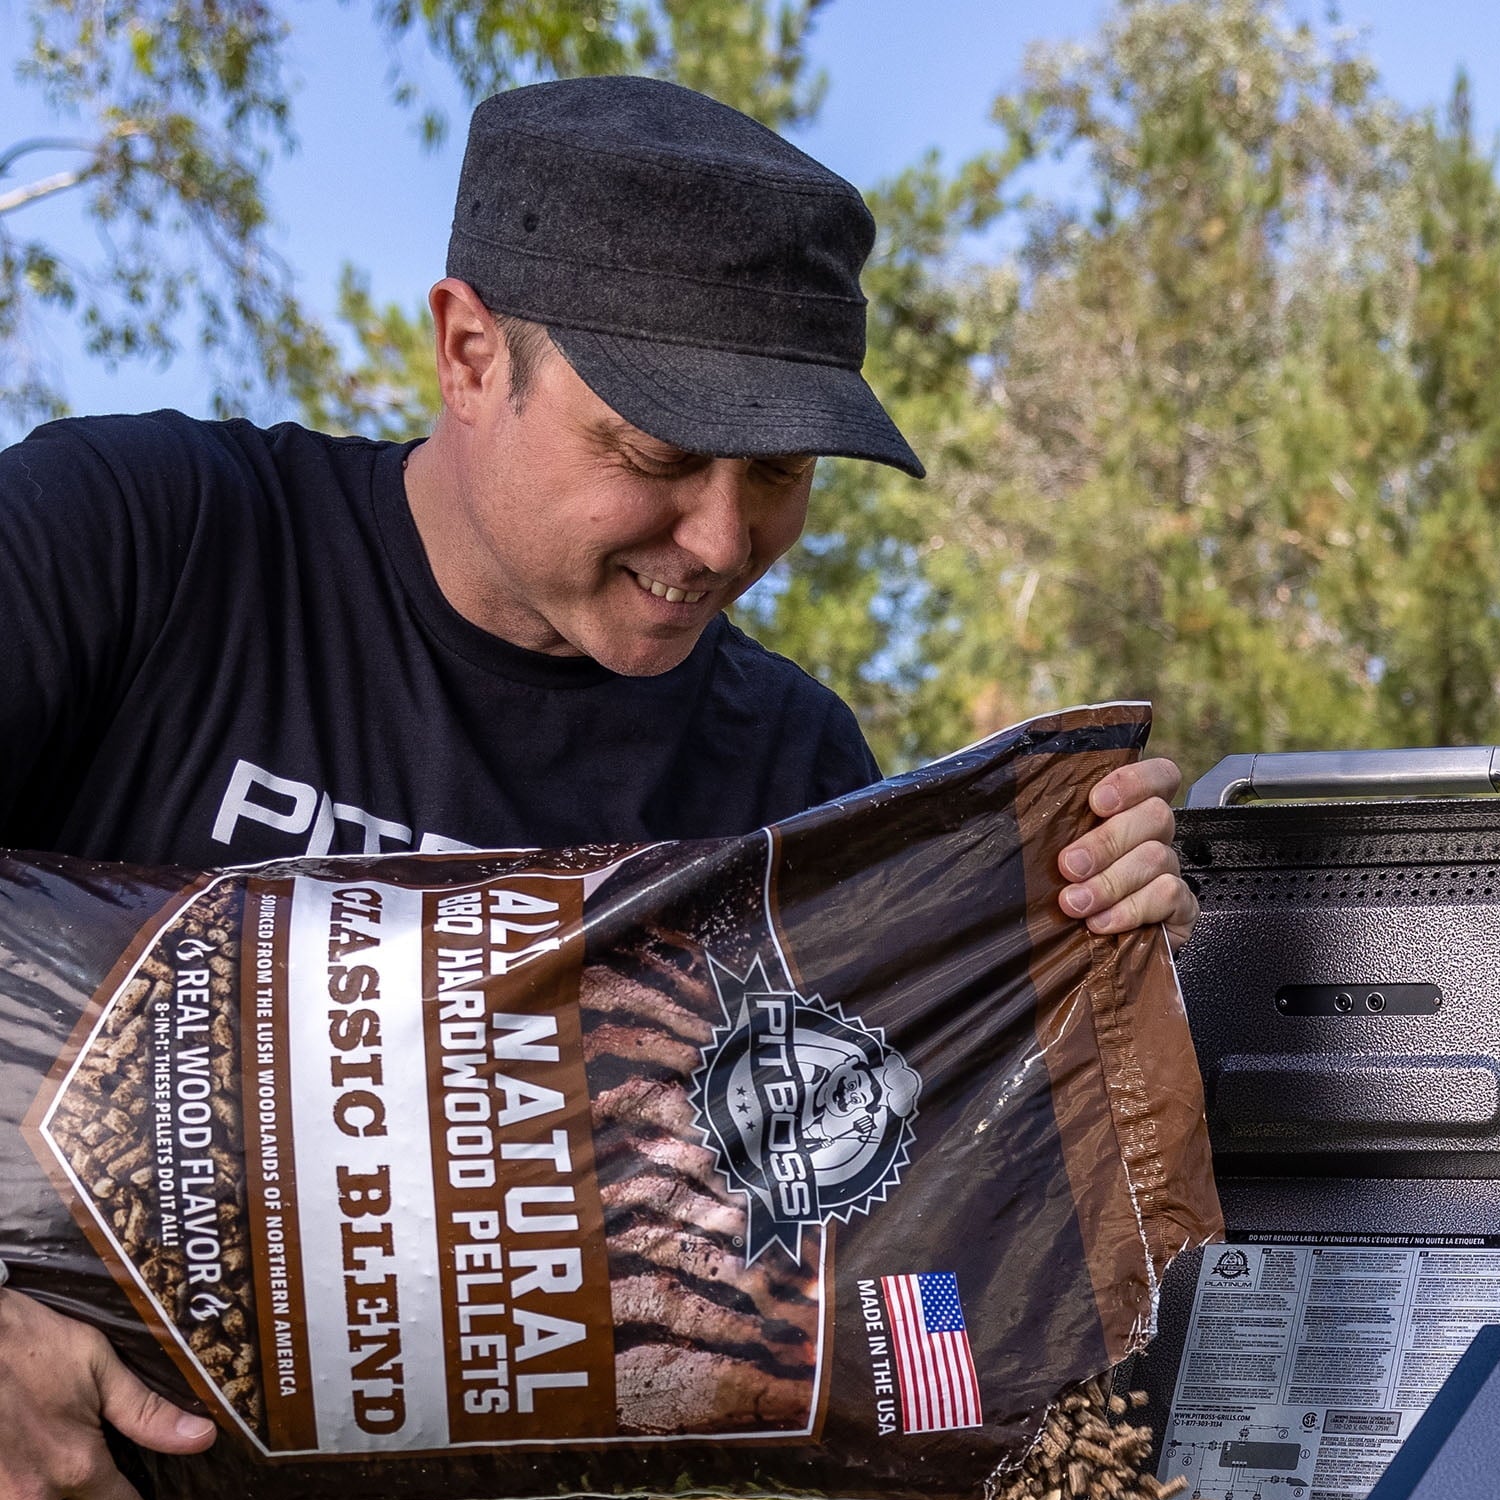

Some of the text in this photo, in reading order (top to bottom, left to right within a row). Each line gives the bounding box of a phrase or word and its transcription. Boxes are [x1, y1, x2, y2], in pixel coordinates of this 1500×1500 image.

[434, 892, 483, 935] BBQ
[155, 1002, 178, 1246] 8-IN-1: THESE PELLETS DO IT ALL!
[177, 969, 222, 1284] REAL WOOD FLAVOR
[256, 894, 297, 1396] SOURCED FROM THE LUSH WOODLANDS OF NORTHERN AMERICA
[327, 888, 406, 1435] CLASSIC BLEND
[437, 948, 496, 1189] HARDWOOD
[489, 889, 588, 1413] ALL NATURAL
[756, 1000, 811, 1216] PIT BOSS
[452, 1211, 510, 1414] PELLETS
[857, 1279, 896, 1436] MADE IN THE USA
[1174, 1412, 1251, 1421] WWW.PITBOSS-GRILLS.COM
